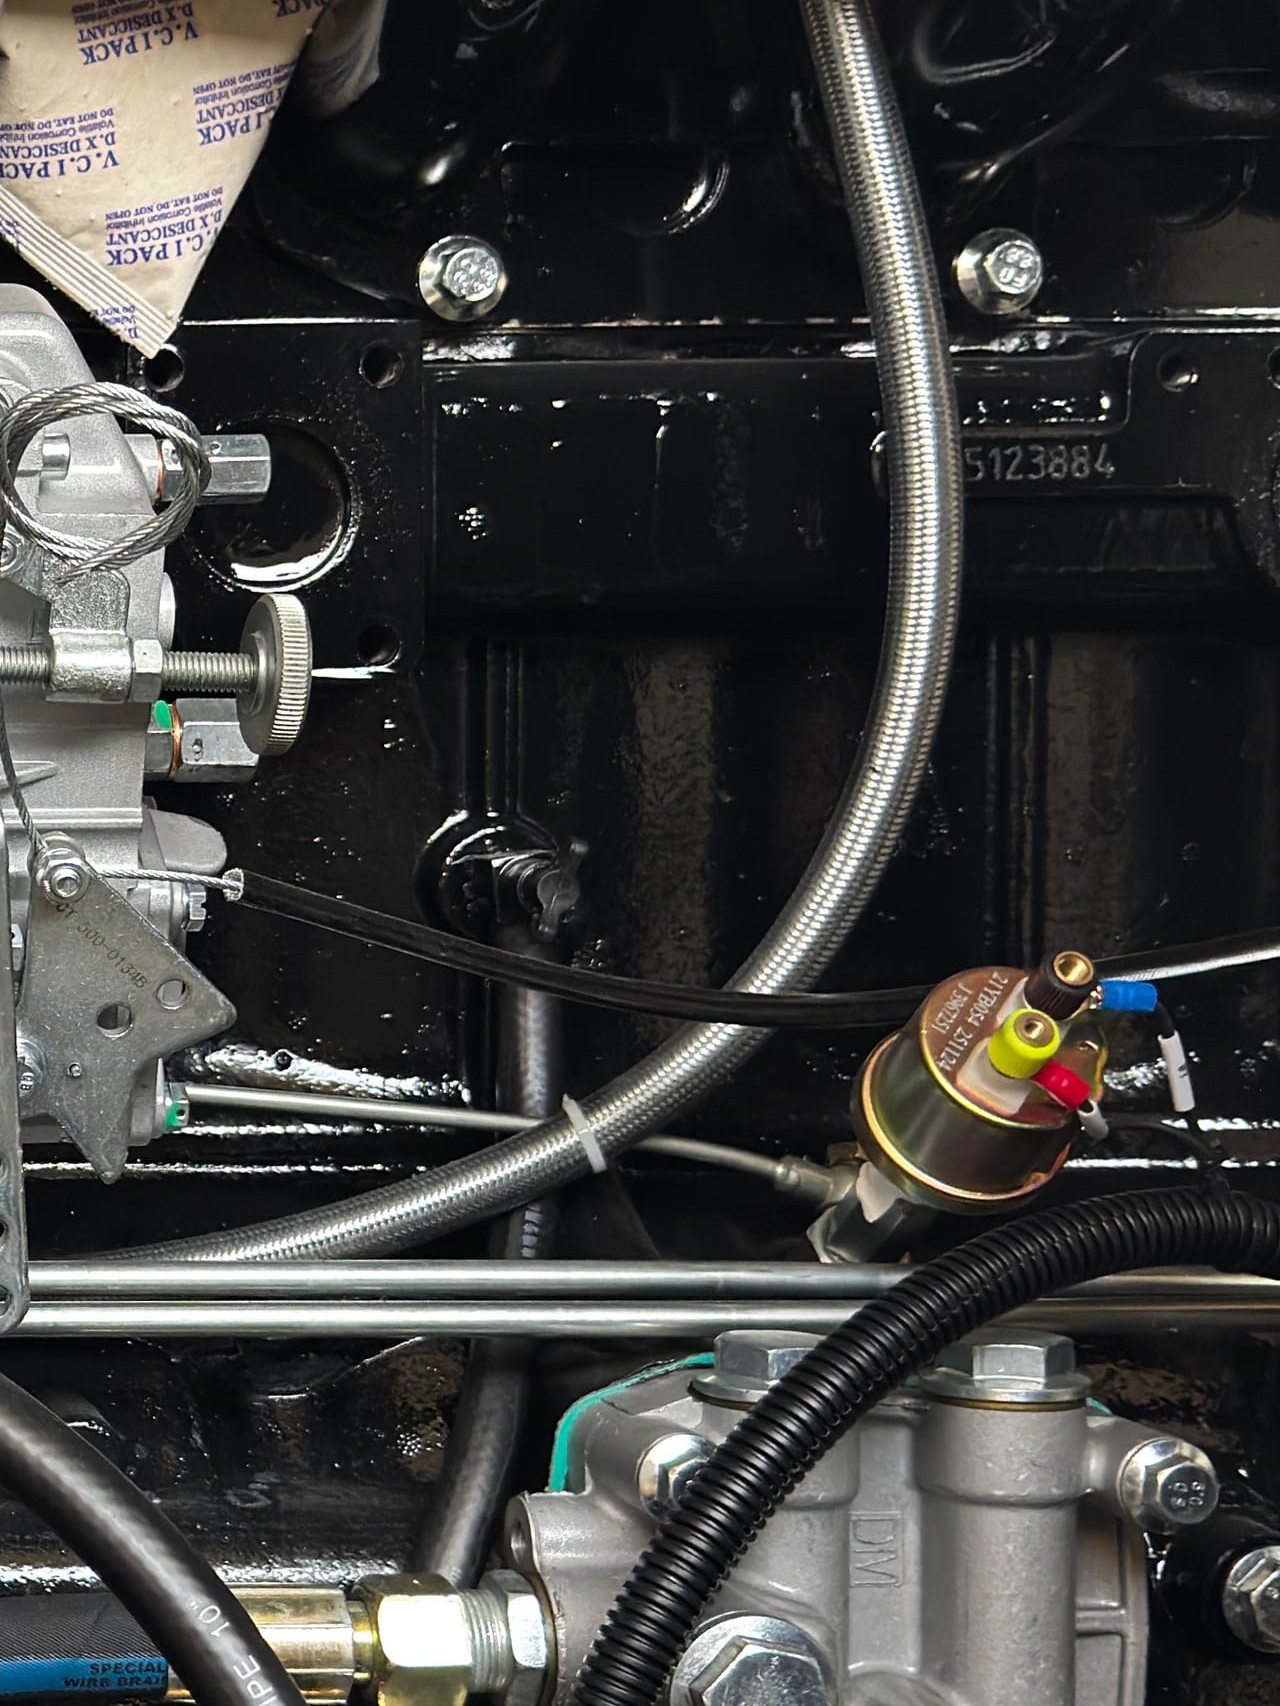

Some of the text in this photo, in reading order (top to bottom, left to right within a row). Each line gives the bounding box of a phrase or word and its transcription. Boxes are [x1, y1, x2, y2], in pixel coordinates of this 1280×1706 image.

[77, 11, 162, 43] DESICCANT
[79, 35, 138, 66] PACK
[192, 82, 216, 95] OPEN
[218, 77, 236, 89] NOT
[100, 108, 114, 117] DO
[196, 91, 274, 124] DESICCANT
[78, 111, 97, 123] NOT
[37, 121, 52, 130] DO
[79, 119, 114, 133] Volatile
[196, 115, 251, 146] PACK
[28, 127, 76, 141] Corrosion
[192, 190, 209, 202] NOT
[211, 186, 223, 196] DO
[134, 205, 153, 216] NOT
[156, 201, 169, 211] DO
[105, 209, 131, 221] OPEN
[106, 198, 222, 230] Volatile Corrosion Inhibitor
[106, 218, 195, 246] DESICCANT
[106, 243, 168, 266] PACK
[964, 443, 1115, 481] 5123884
[117, 1676, 167, 1687] BRAI
